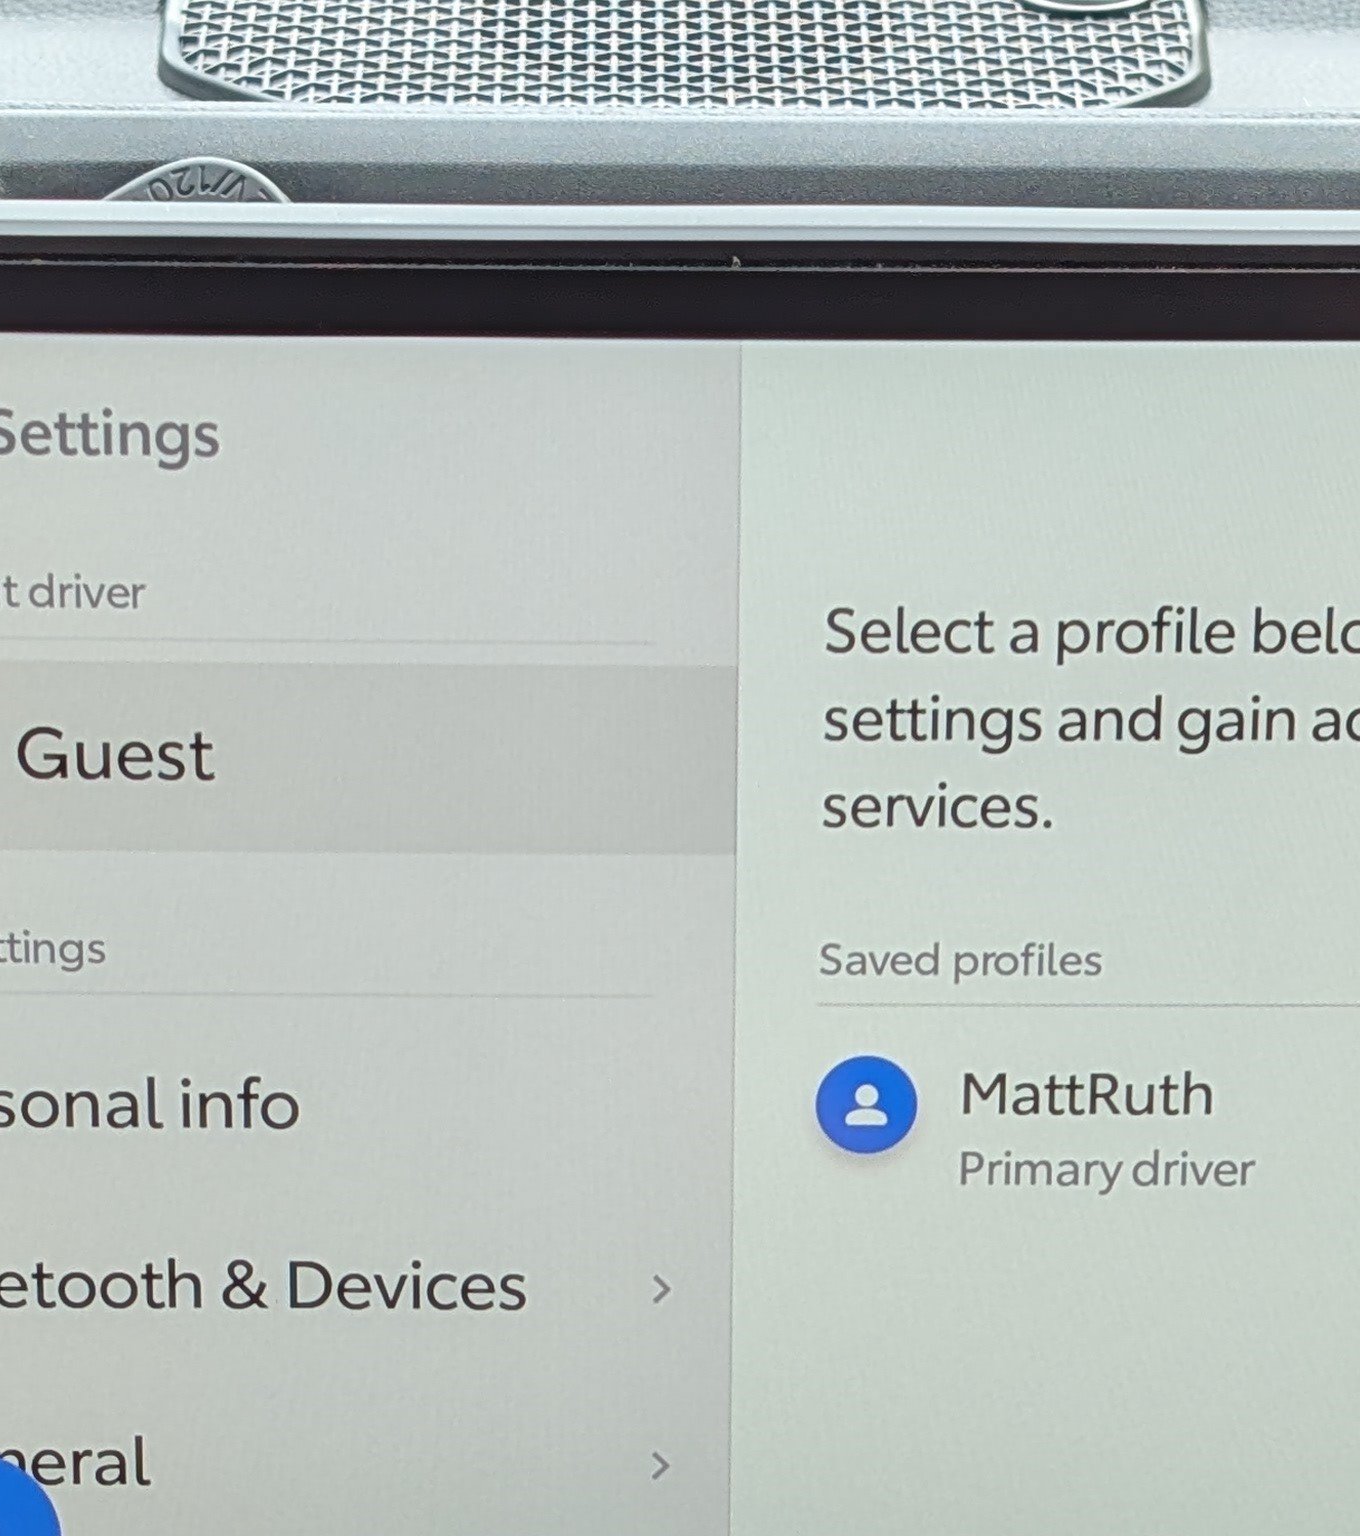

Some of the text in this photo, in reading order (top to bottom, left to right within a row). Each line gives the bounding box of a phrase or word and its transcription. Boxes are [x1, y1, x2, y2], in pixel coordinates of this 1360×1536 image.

[29, 573, 146, 609] driver
[826, 606, 994, 654] Select
[1010, 620, 1038, 654] a
[1057, 606, 1235, 665] profile
[825, 695, 1041, 754] settings
[1059, 695, 1162, 741] and
[1178, 695, 1295, 754] gain
[18, 727, 215, 780] Guest
[823, 782, 1051, 828] services.
[820, 942, 1101, 984] Saved profiles
[182, 1076, 299, 1129] info
[963, 1071, 1212, 1115] MattRuth
[961, 1149, 1256, 1195] Primary driver
[223, 1260, 268, 1309] &
[290, 1260, 526, 1310] Devices
